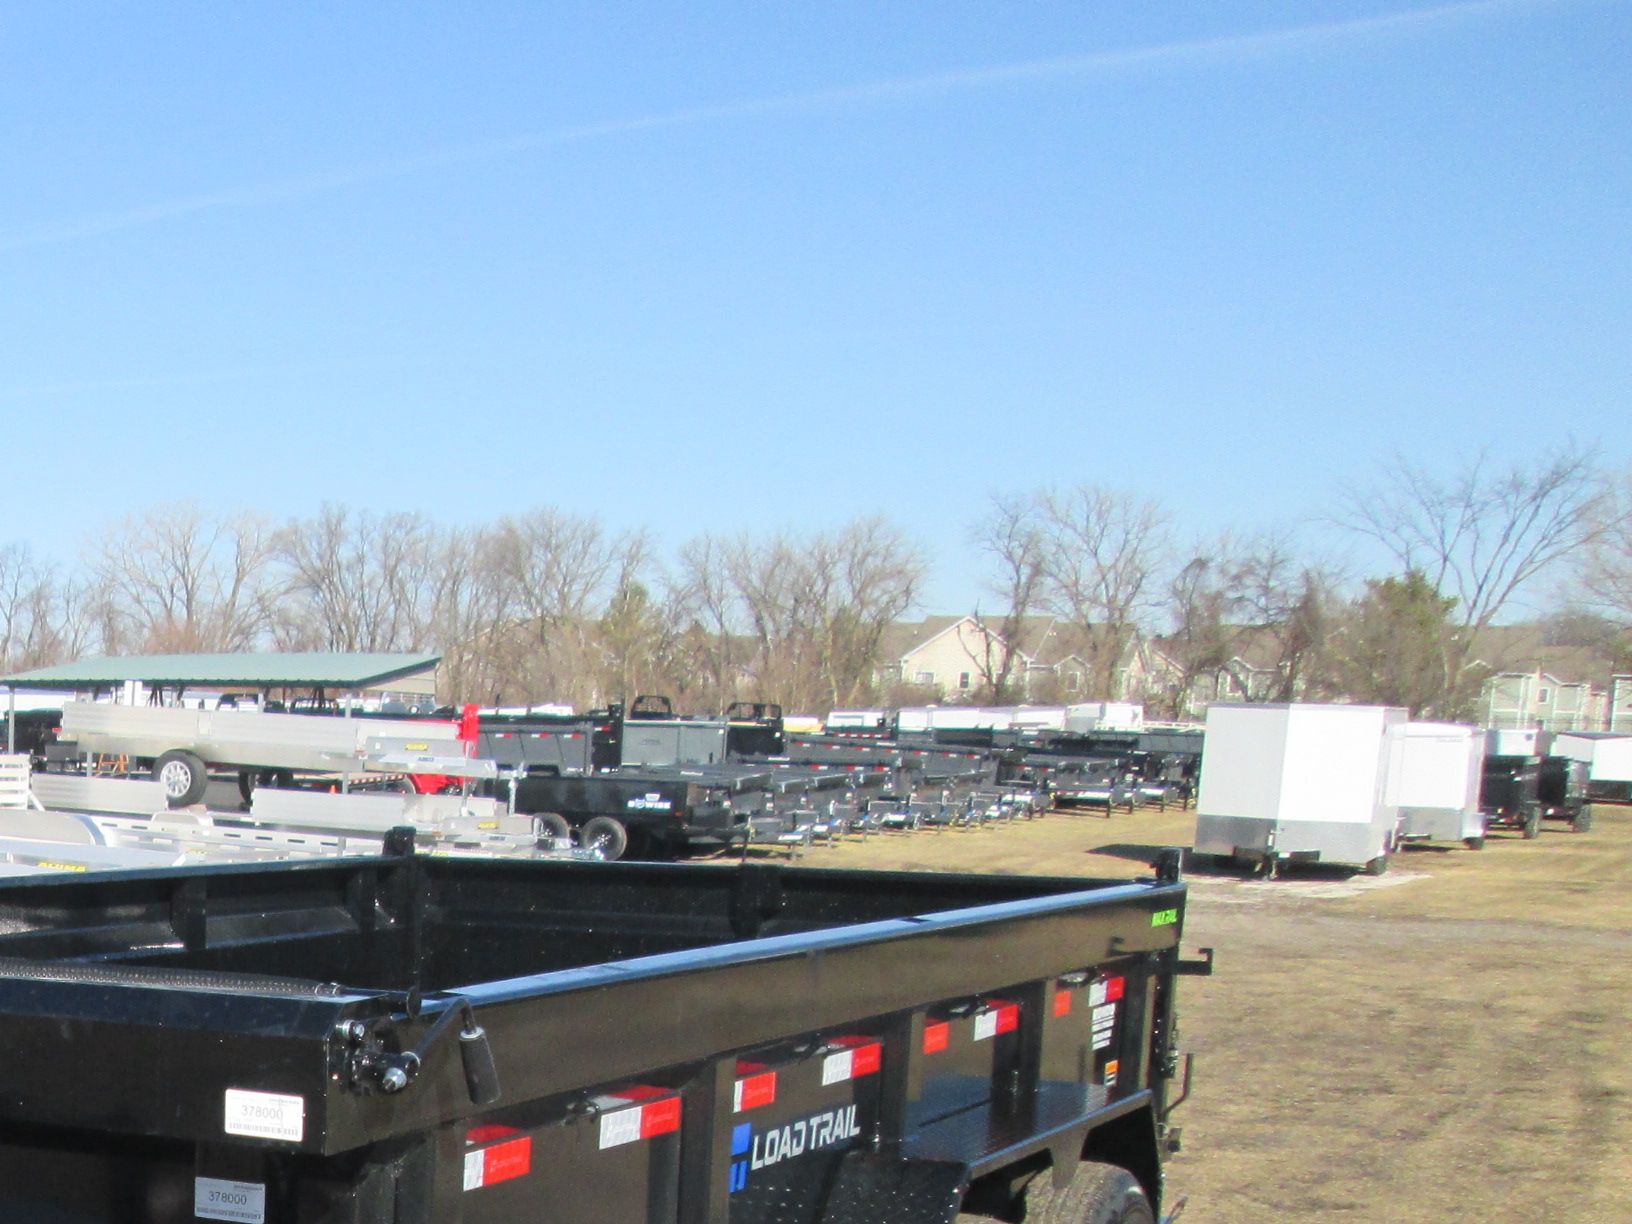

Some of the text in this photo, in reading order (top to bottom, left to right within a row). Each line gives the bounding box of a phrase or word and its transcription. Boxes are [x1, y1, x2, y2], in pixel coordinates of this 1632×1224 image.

[241, 1104, 284, 1119] 378000
[751, 1104, 862, 1171] LOAD TRAIL
[208, 1191, 248, 1205] 378000
